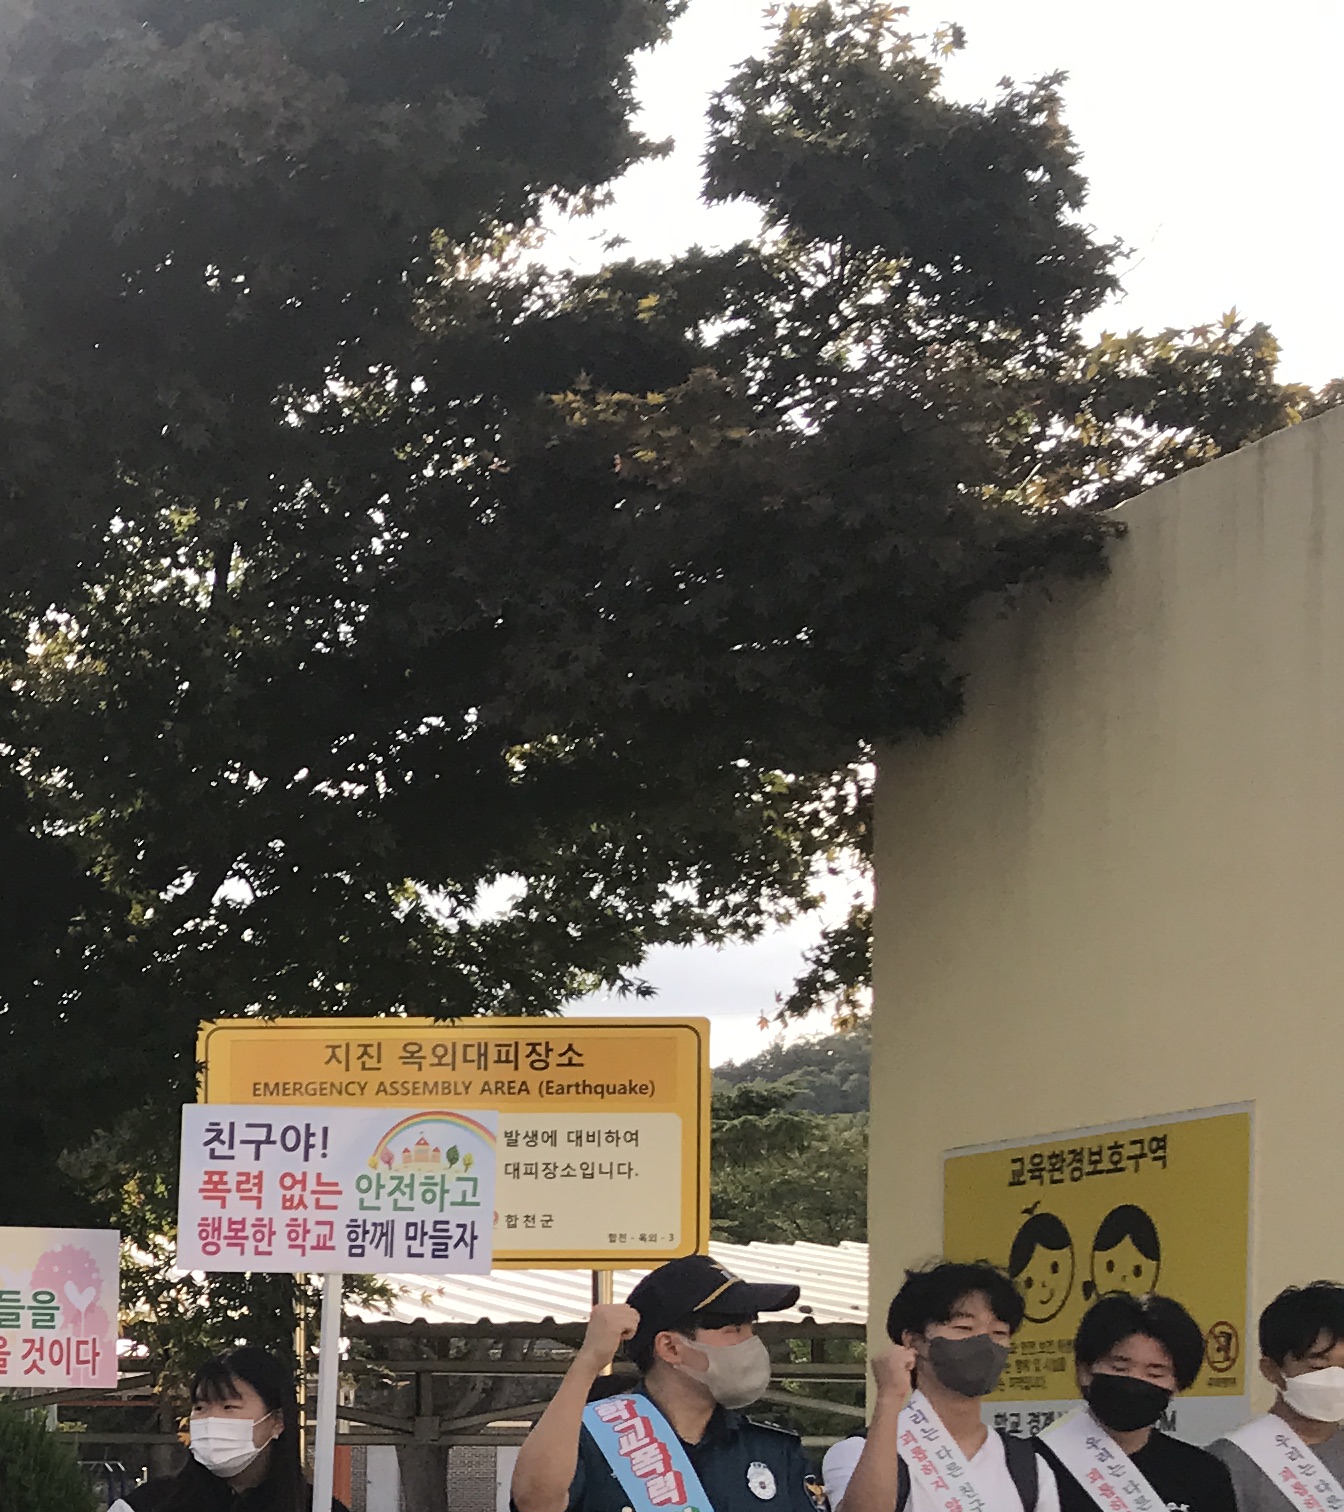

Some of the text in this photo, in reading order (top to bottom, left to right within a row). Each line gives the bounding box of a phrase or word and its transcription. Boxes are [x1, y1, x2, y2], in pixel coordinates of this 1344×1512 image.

[324, 1040, 586, 1072] 지진 옥외대피장소
[252, 1079, 655, 1099] EMERGENCY ASSEMBLY AREA (Earthquake)
[202, 1120, 329, 1161] 친구야!
[504, 1129, 639, 1148] 발생에 대비하여
[504, 1161, 639, 1180] 대피장소입니다.
[1007, 1133, 1168, 1187] 교육환경보호구역
[198, 1170, 481, 1212] 폭력 없는 안전하고
[197, 1216, 478, 1260] 행복한 학교 함께 만들자
[504, 1214, 554, 1229] 합천군
[20, 1337, 101, 1376] 것이다
[593, 1399, 688, 1506] 학교폭력
[1085, 1436, 1127, 1477] 우리는
